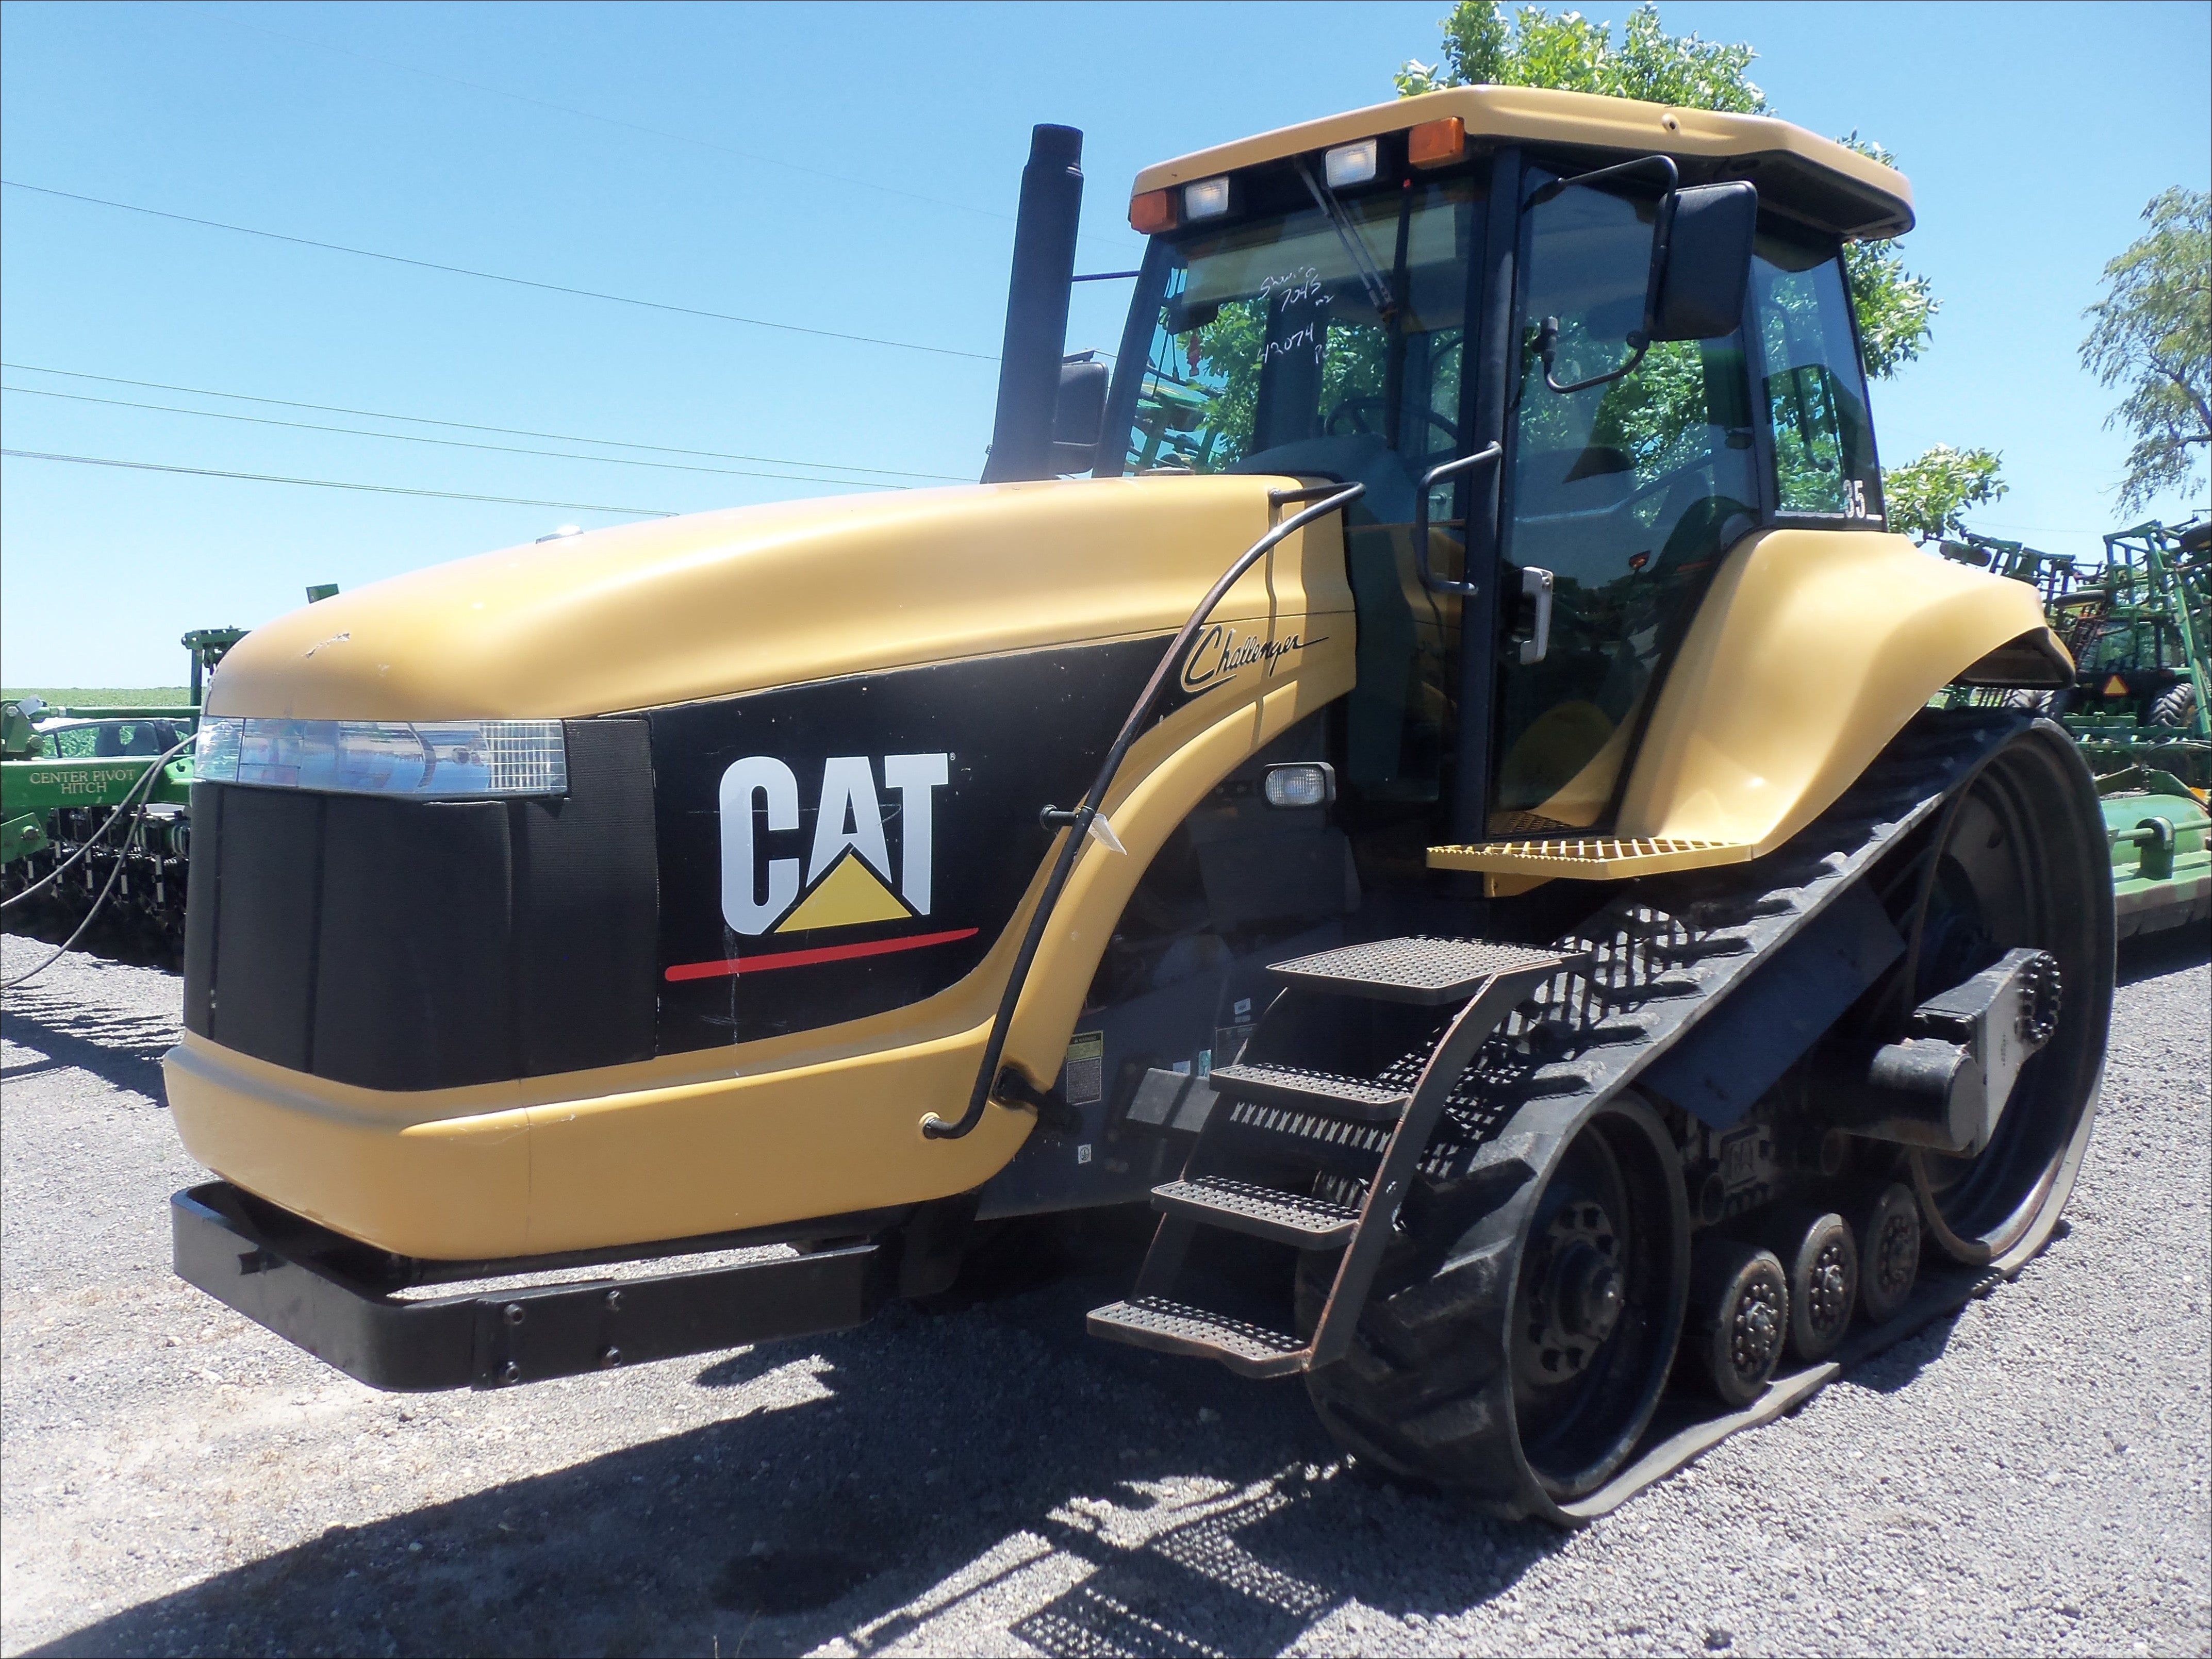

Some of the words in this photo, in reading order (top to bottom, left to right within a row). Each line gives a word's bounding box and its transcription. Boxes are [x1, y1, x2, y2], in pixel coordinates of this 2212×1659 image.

[1843, 479, 1866, 518] 35
[1184, 624, 1329, 686] Challenger
[30, 771, 88, 784] CENTER
[93, 769, 136, 782] PIVOT
[61, 782, 107, 794] HITCH
[719, 753, 949, 935] CAT
